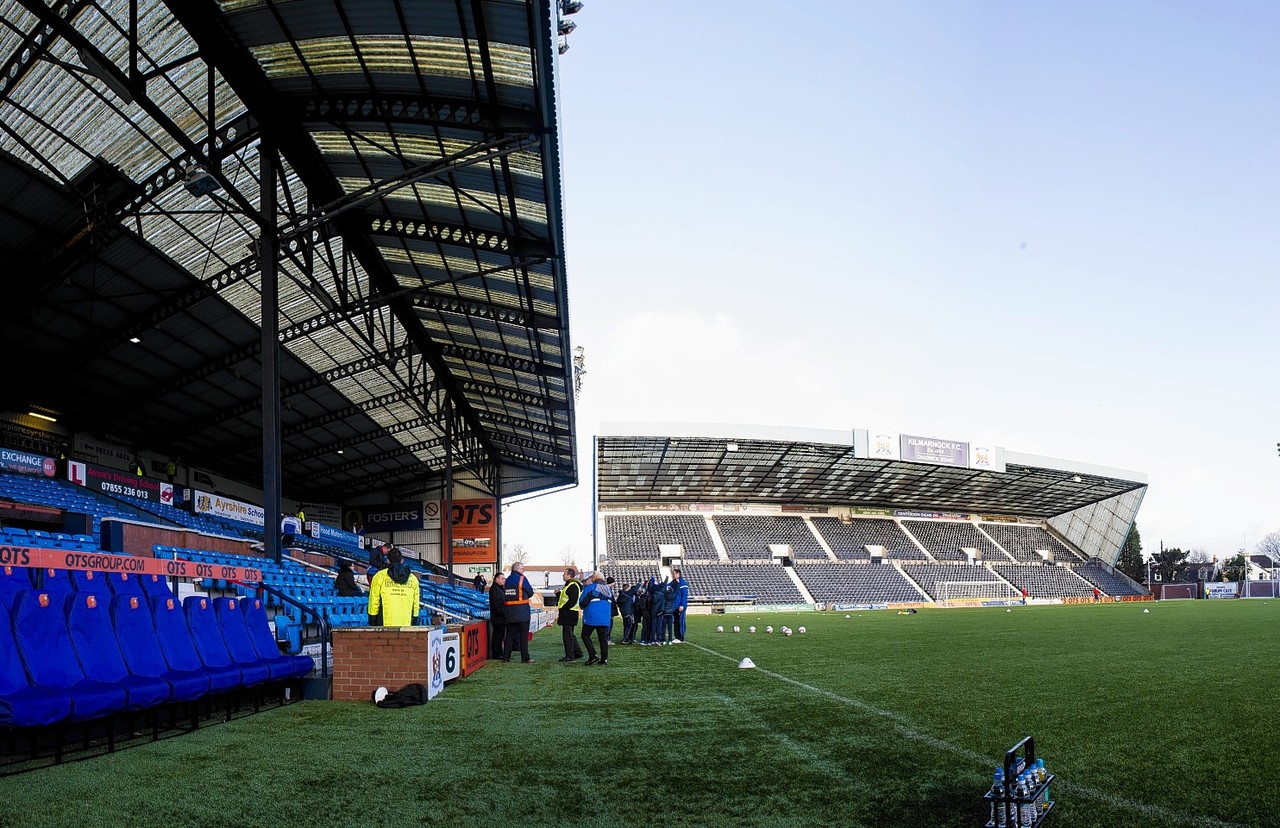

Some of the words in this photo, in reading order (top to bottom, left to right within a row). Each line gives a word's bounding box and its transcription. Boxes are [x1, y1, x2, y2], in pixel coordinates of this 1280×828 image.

[95, 446, 114, 457] PRESS
[116, 451, 130, 462] AREA
[907, 438, 951, 450] KILMARNOCK
[951, 443, 962, 451] F.C.
[2, 451, 42, 467] EXCHANGE
[72, 464, 83, 485] L
[87, 467, 112, 481] Avon's
[113, 473, 138, 487] Driving
[138, 478, 160, 491] School
[101, 481, 123, 494] 07855
[123, 486, 136, 497] 236
[136, 488, 149, 499] 013
[215, 498, 247, 514] Ayrshire
[446, 504, 493, 525] QTS
[367, 510, 419, 523] FOSTER'S
[0, 548, 30, 566] QTS
[65, 553, 145, 572] QTSGROUP.COM
[166, 561, 186, 575] QTS
[196, 563, 213, 578] QTS
[221, 566, 237, 580] QTS
[244, 568, 258, 581] QTS
[467, 628, 480, 659] QTS
[445, 646, 456, 674] 6
